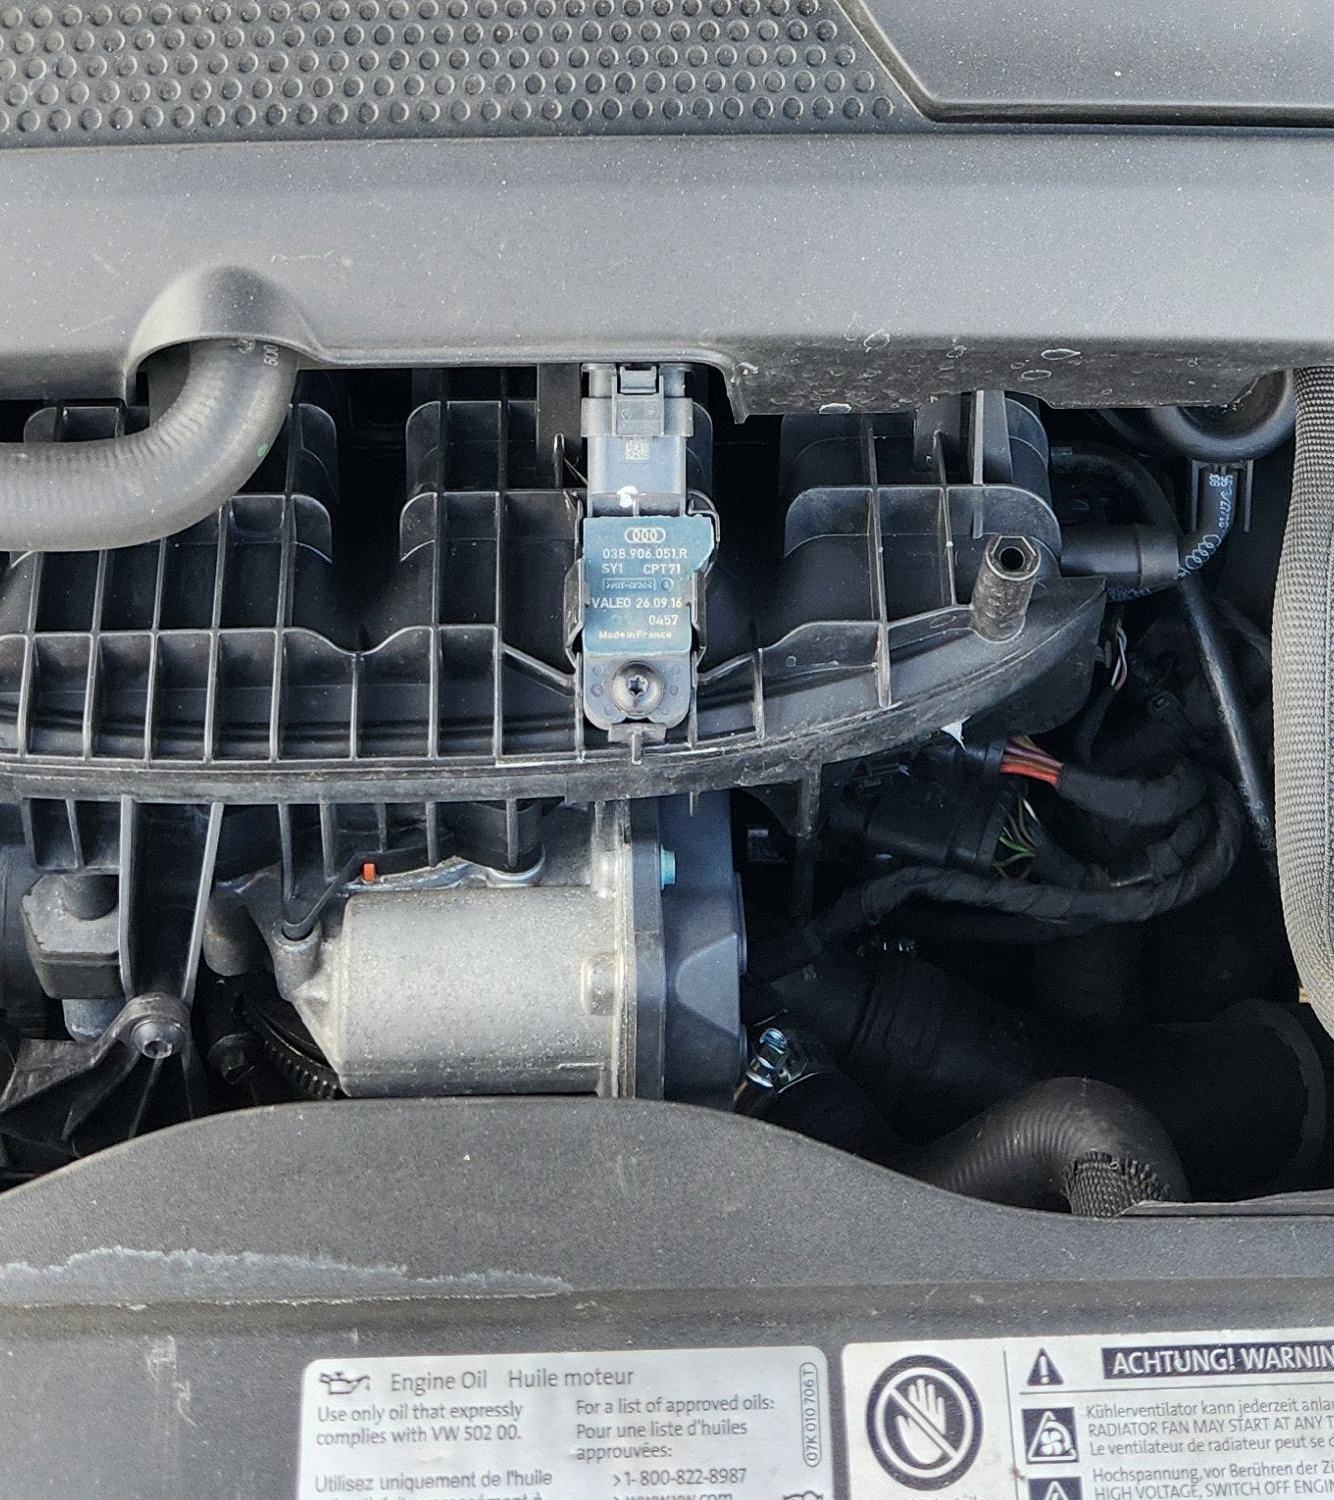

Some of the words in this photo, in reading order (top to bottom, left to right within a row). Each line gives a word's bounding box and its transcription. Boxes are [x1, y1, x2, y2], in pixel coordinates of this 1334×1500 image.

[601, 563, 624, 575] SY1
[592, 597, 632, 609] VALEO
[636, 597, 683, 609] 26.09.16
[1113, 1348, 1235, 1374] ACHTUNG!
[391, 1372, 455, 1396] Engine
[461, 1370, 487, 1389] Oil
[509, 1368, 558, 1387] Huile
[565, 1368, 634, 1386] moteur
[318, 1406, 347, 1422] Use
[351, 1404, 385, 1425] only
[389, 1403, 408, 1420] oil
[412, 1403, 445, 1419] that
[450, 1400, 523, 1421] expressly
[576, 1400, 600, 1414] For
[605, 1403, 613, 1413] a
[619, 1397, 642, 1413] list
[646, 1396, 663, 1413] of
[666, 1395, 738, 1417] approved
[743, 1394, 774, 1410] oils:
[1087, 1402, 1198, 1418] Kühlerventilator
[1201, 1400, 1235, 1414] kann
[1239, 1398, 1299, 1418] jederzeit
[317, 1427, 387, 1449] complies
[391, 1426, 427, 1442] with
[431, 1426, 459, 1441] VW
[465, 1425, 492, 1441] 502
[497, 1424, 521, 1440] 00.
[577, 1424, 612, 1438] Pour
[617, 1426, 646, 1437] une
[651, 1421, 683, 1437] liste
[687, 1419, 747, 1436] d'huiles
[1089, 1422, 1158, 1437] RADIATOR
[1162, 1420, 1189, 1434] FAN
[1193, 1419, 1224, 1433] MAY
[1228, 1418, 1269, 1432] START
[1274, 1417, 1290, 1430] AT
[1295, 1416, 1322, 1429] ANY
[576, 1442, 672, 1464] approuvées:
[1090, 1442, 1105, 1456] Le
[1108, 1440, 1183, 1455] ventilateur
[1187, 1438, 1205, 1452] de
[1208, 1437, 1270, 1451] radiateur
[1275, 1435, 1307, 1452] peut
[1310, 1437, 1325, 1448] se
[316, 1475, 374, 1492] Utilisez
[381, 1471, 476, 1493] uniquement
[481, 1471, 501, 1487] de
[507, 1470, 552, 1486] l'huile
[1201, 1468, 1226, 1480] vor
[1229, 1462, 1293, 1482] Berühren
[1294, 1460, 1321, 1481] der
[1135, 1482, 1202, 1499] VOLTAGE,
[1205, 1482, 1260, 1497] SWITCH
[1264, 1480, 1289, 1495] OFF
